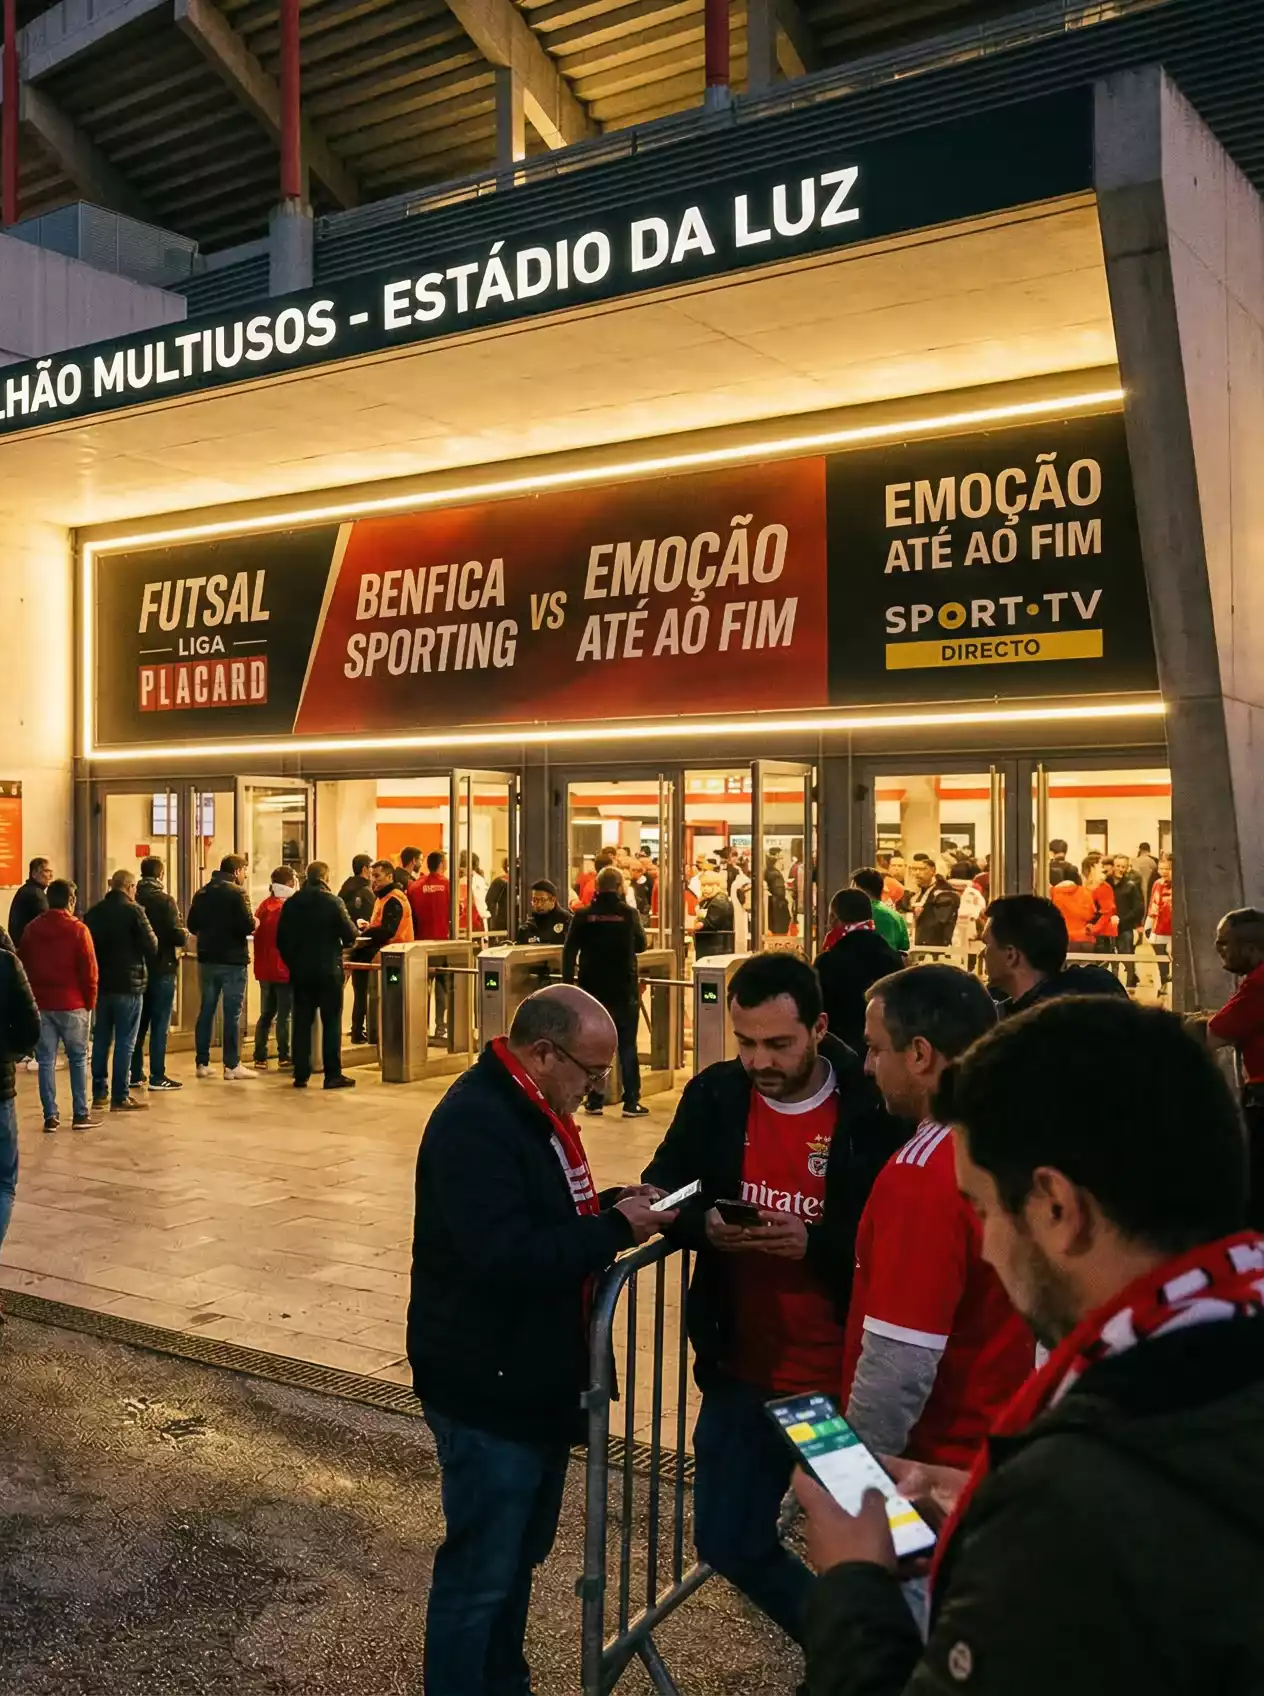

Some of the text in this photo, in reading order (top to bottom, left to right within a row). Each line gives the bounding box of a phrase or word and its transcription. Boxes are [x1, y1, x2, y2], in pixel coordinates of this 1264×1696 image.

[93, 299, 336, 399] MULTIUSOS
[349, 311, 369, 326] -
[383, 231, 611, 331] ESTÁDIO
[631, 206, 715, 273] DA
[735, 166, 860, 248] LUZ
[885, 452, 1102, 528] EMOÇÃO
[583, 513, 789, 603] EMOÇÃO
[884, 518, 1102, 574] ATÉ AO FIM
[138, 570, 271, 634] FUTSAL
[356, 558, 506, 621] BENFICA
[530, 590, 567, 631] VS
[178, 636, 225, 657] LIGA
[343, 619, 519, 679] SPORTING
[576, 597, 798, 662] ATÉ AO FIM
[941, 638, 1040, 661] DIRECTO
[141, 661, 266, 707] PLACARD
